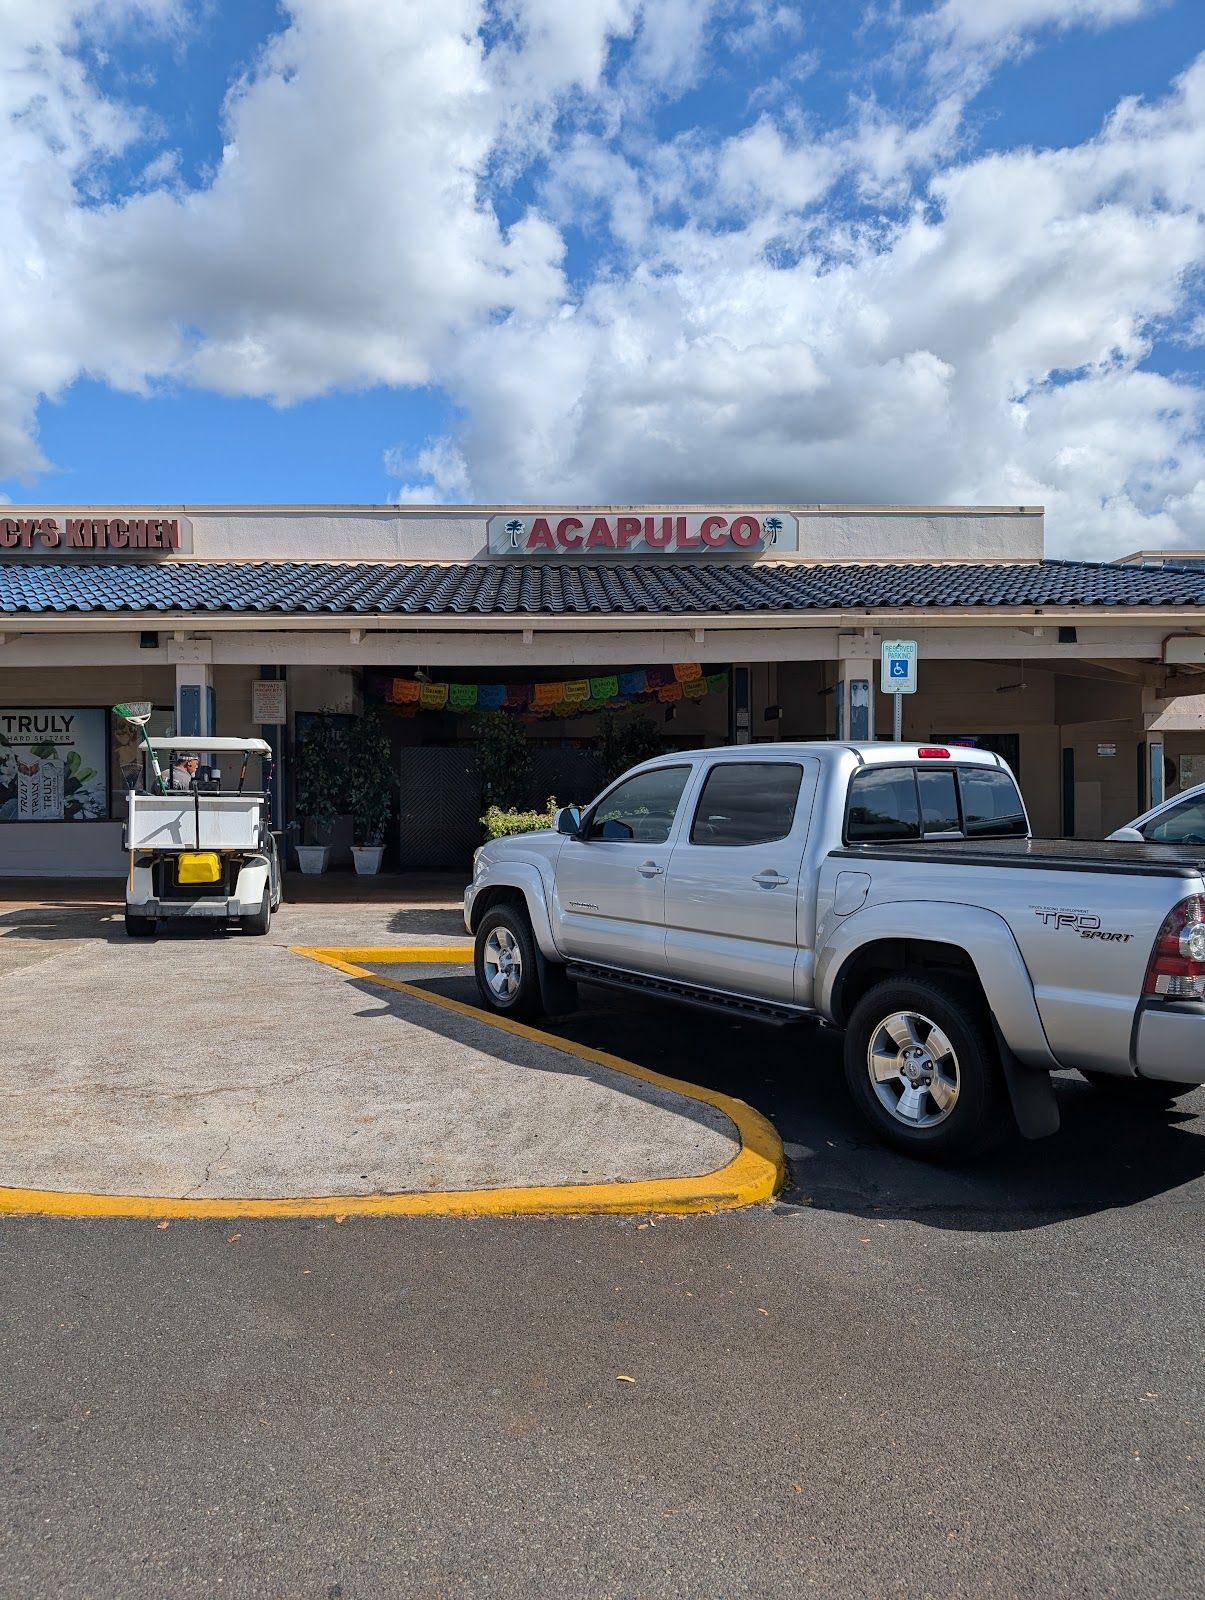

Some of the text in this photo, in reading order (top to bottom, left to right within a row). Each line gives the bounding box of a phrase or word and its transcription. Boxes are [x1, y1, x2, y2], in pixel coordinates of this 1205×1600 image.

[0, 518, 183, 548] CY'S KITCHEN
[527, 516, 761, 548] ACAPULCO
[2, 715, 75, 733] TRULY
[20, 780, 28, 813] TRULY
[31, 782, 39, 815] TRULY
[43, 775, 52, 810] TRULY
[1035, 910, 1101, 933] TRD
[1080, 930, 1135, 943] SPORT
